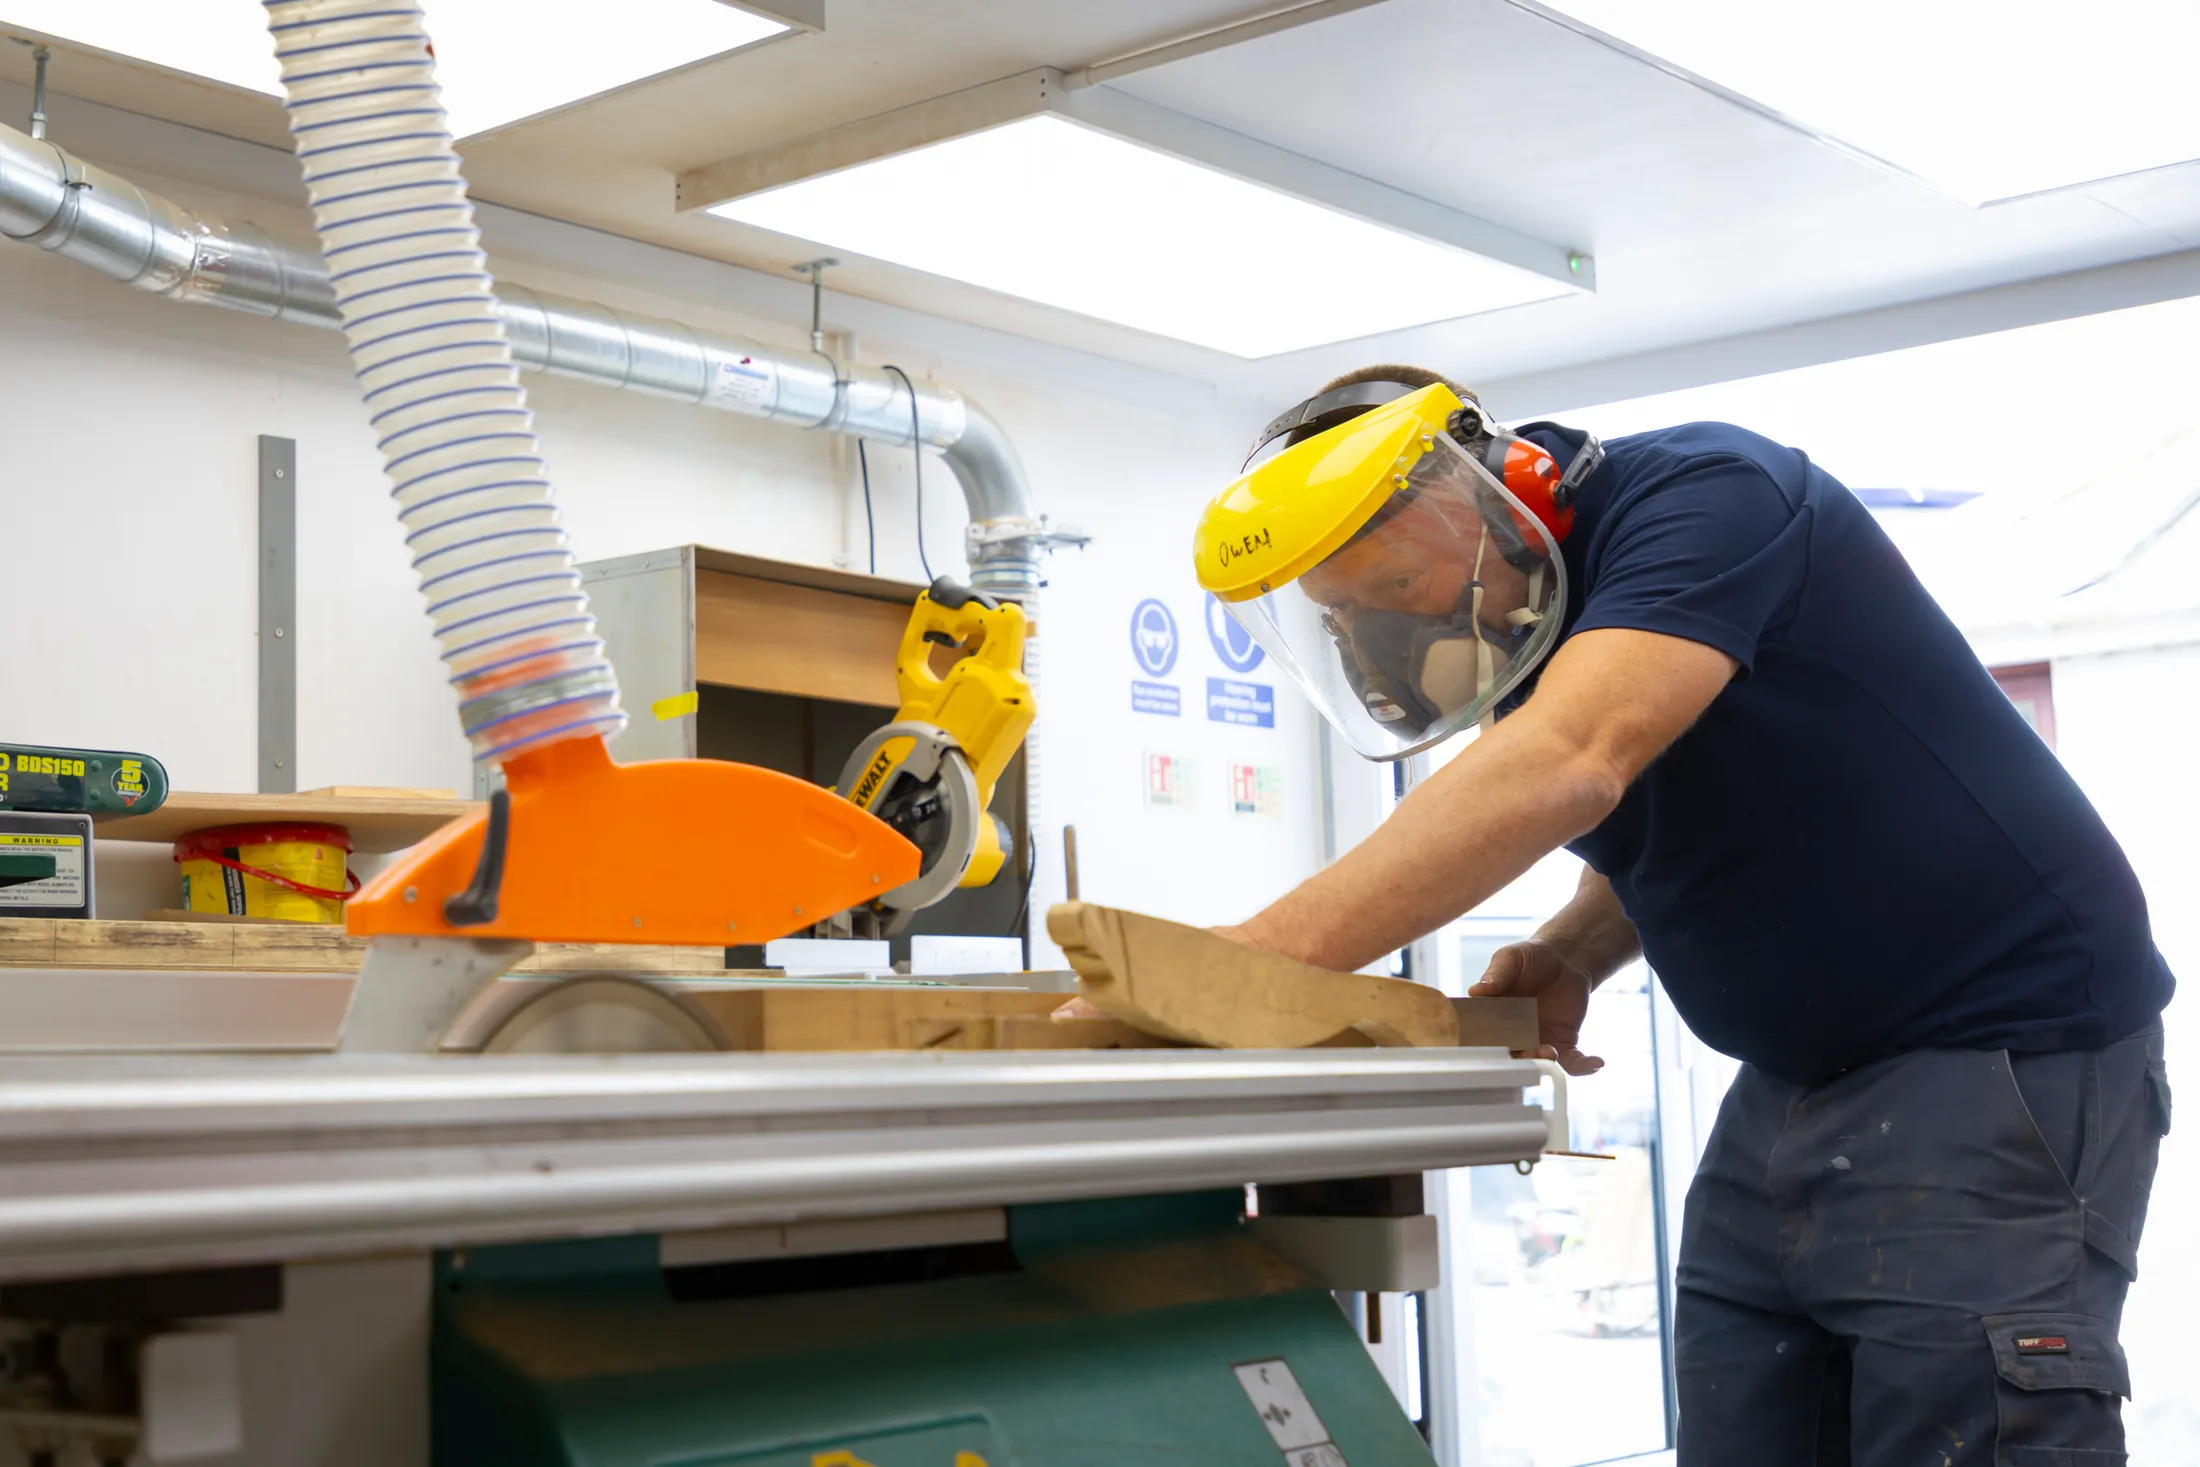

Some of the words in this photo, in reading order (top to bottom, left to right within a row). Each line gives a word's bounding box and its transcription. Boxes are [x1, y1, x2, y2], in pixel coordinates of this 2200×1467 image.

[17, 755, 85, 777] BDS150
[121, 759, 142, 783] 5
[117, 781, 143, 792] YEAR
[855, 750, 891, 807] EWALT
